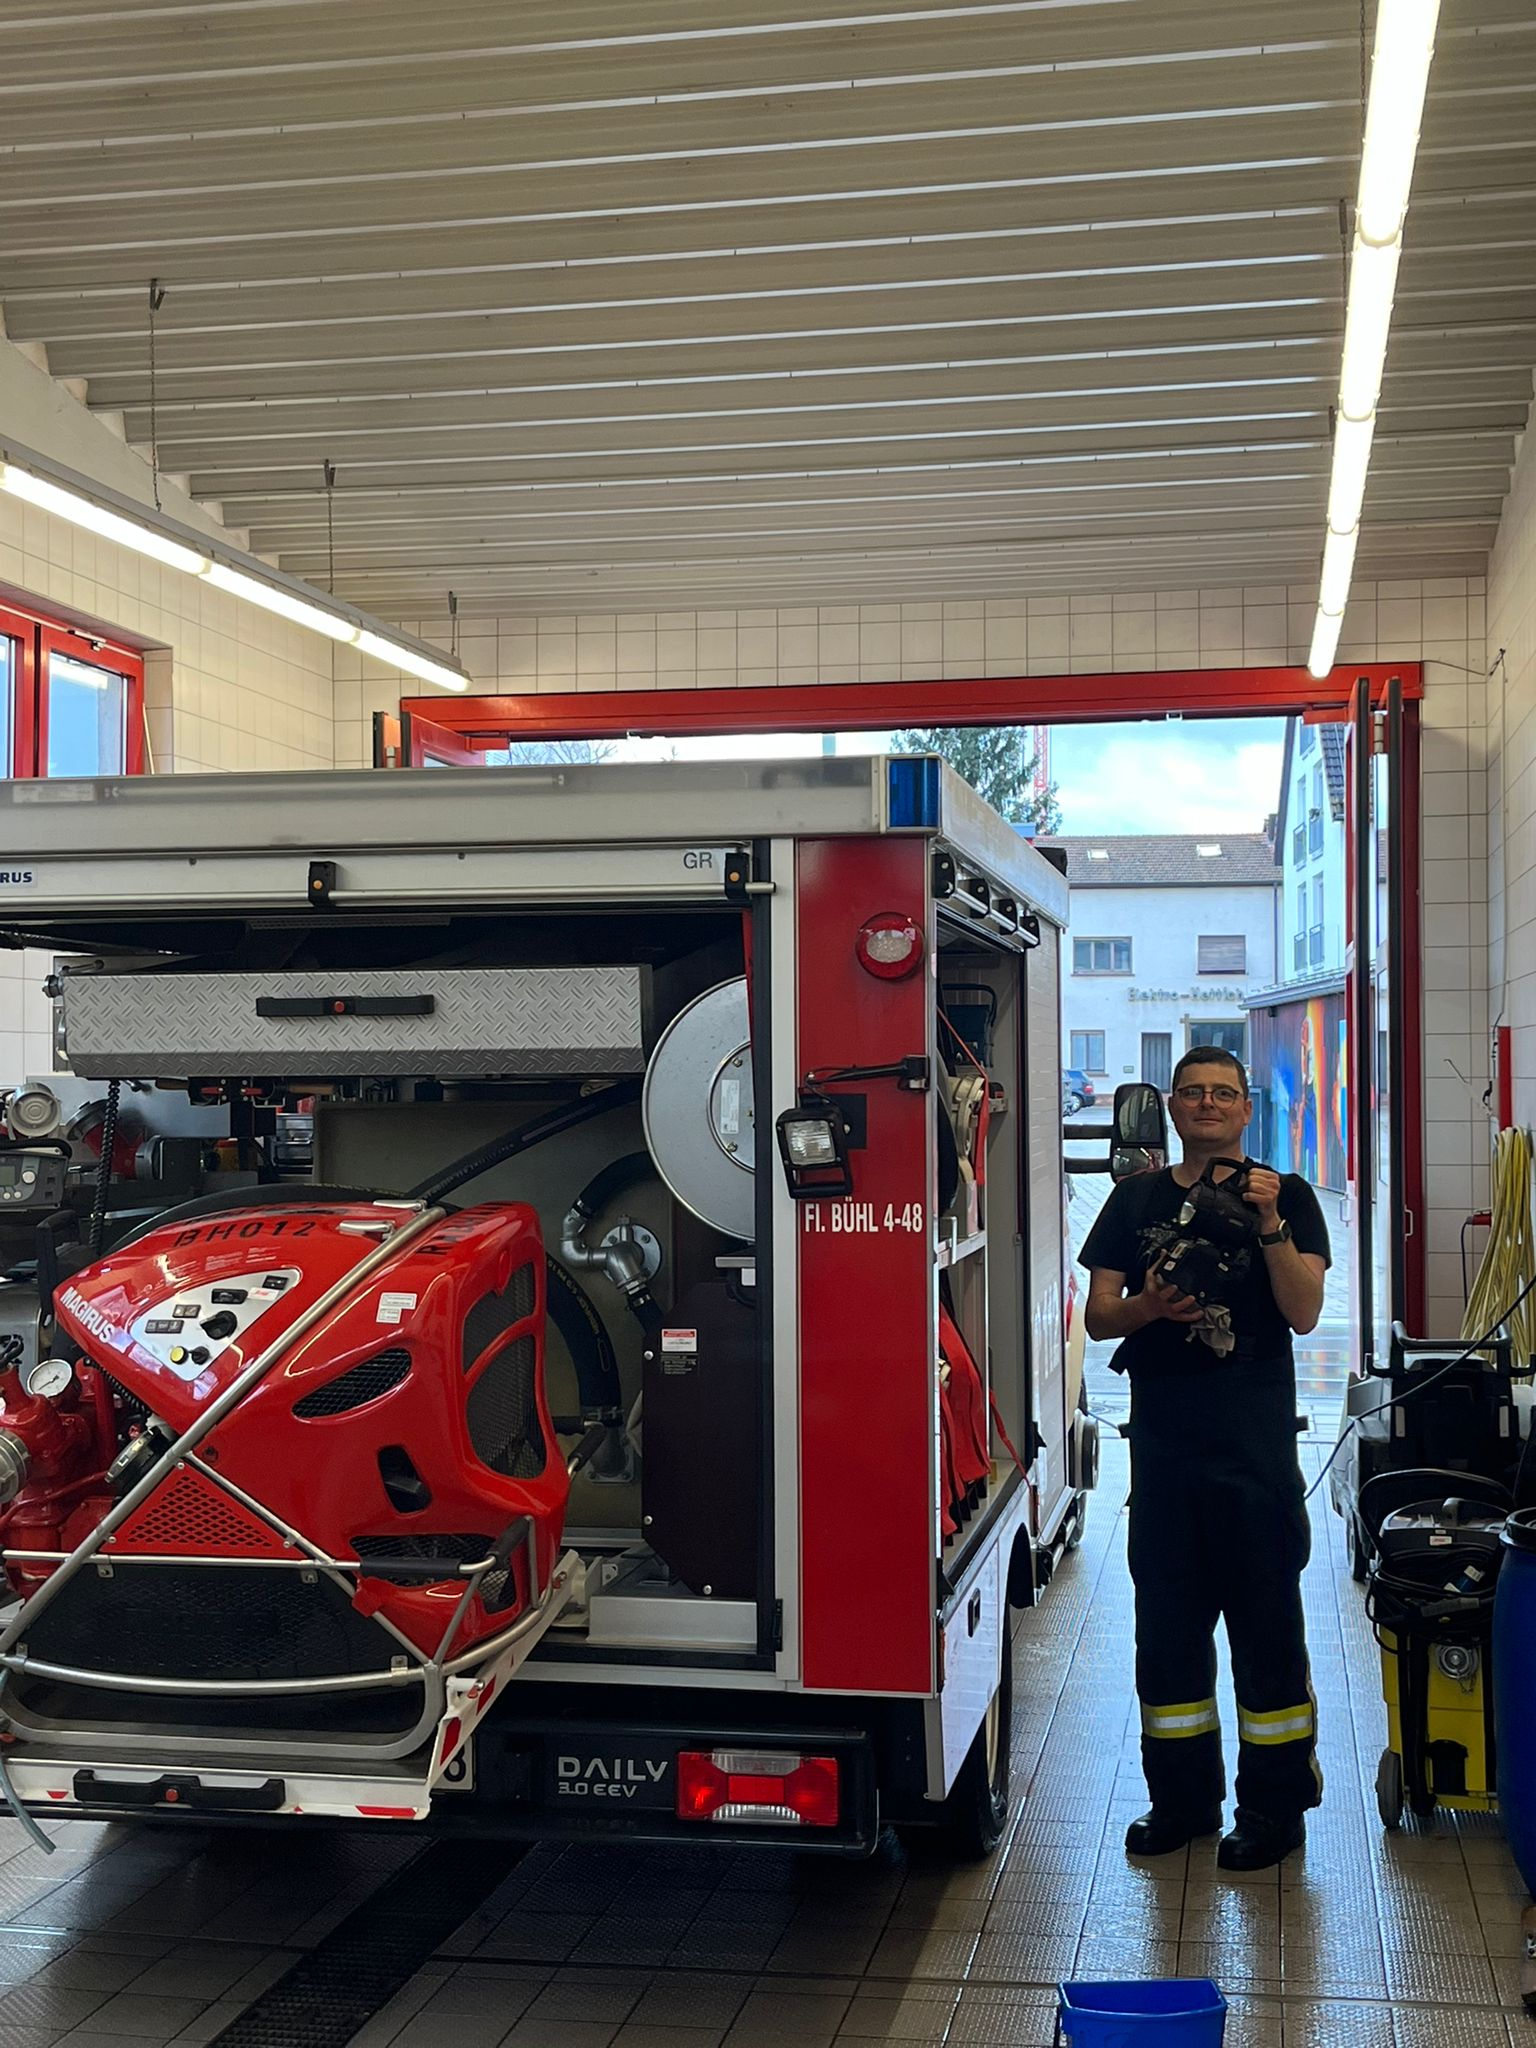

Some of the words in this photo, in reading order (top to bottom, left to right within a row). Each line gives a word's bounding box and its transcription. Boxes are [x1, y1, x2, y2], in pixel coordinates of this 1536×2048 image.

[683, 851, 713, 869] GR
[831, 1196, 879, 1233] BÜHL
[883, 1203, 923, 1232] 4-48
[60, 1286, 115, 1343] MAGIRUS
[558, 1756, 668, 1782] DAILY
[558, 1782, 588, 1795] 3.0
[593, 1783, 637, 1798] EEV
